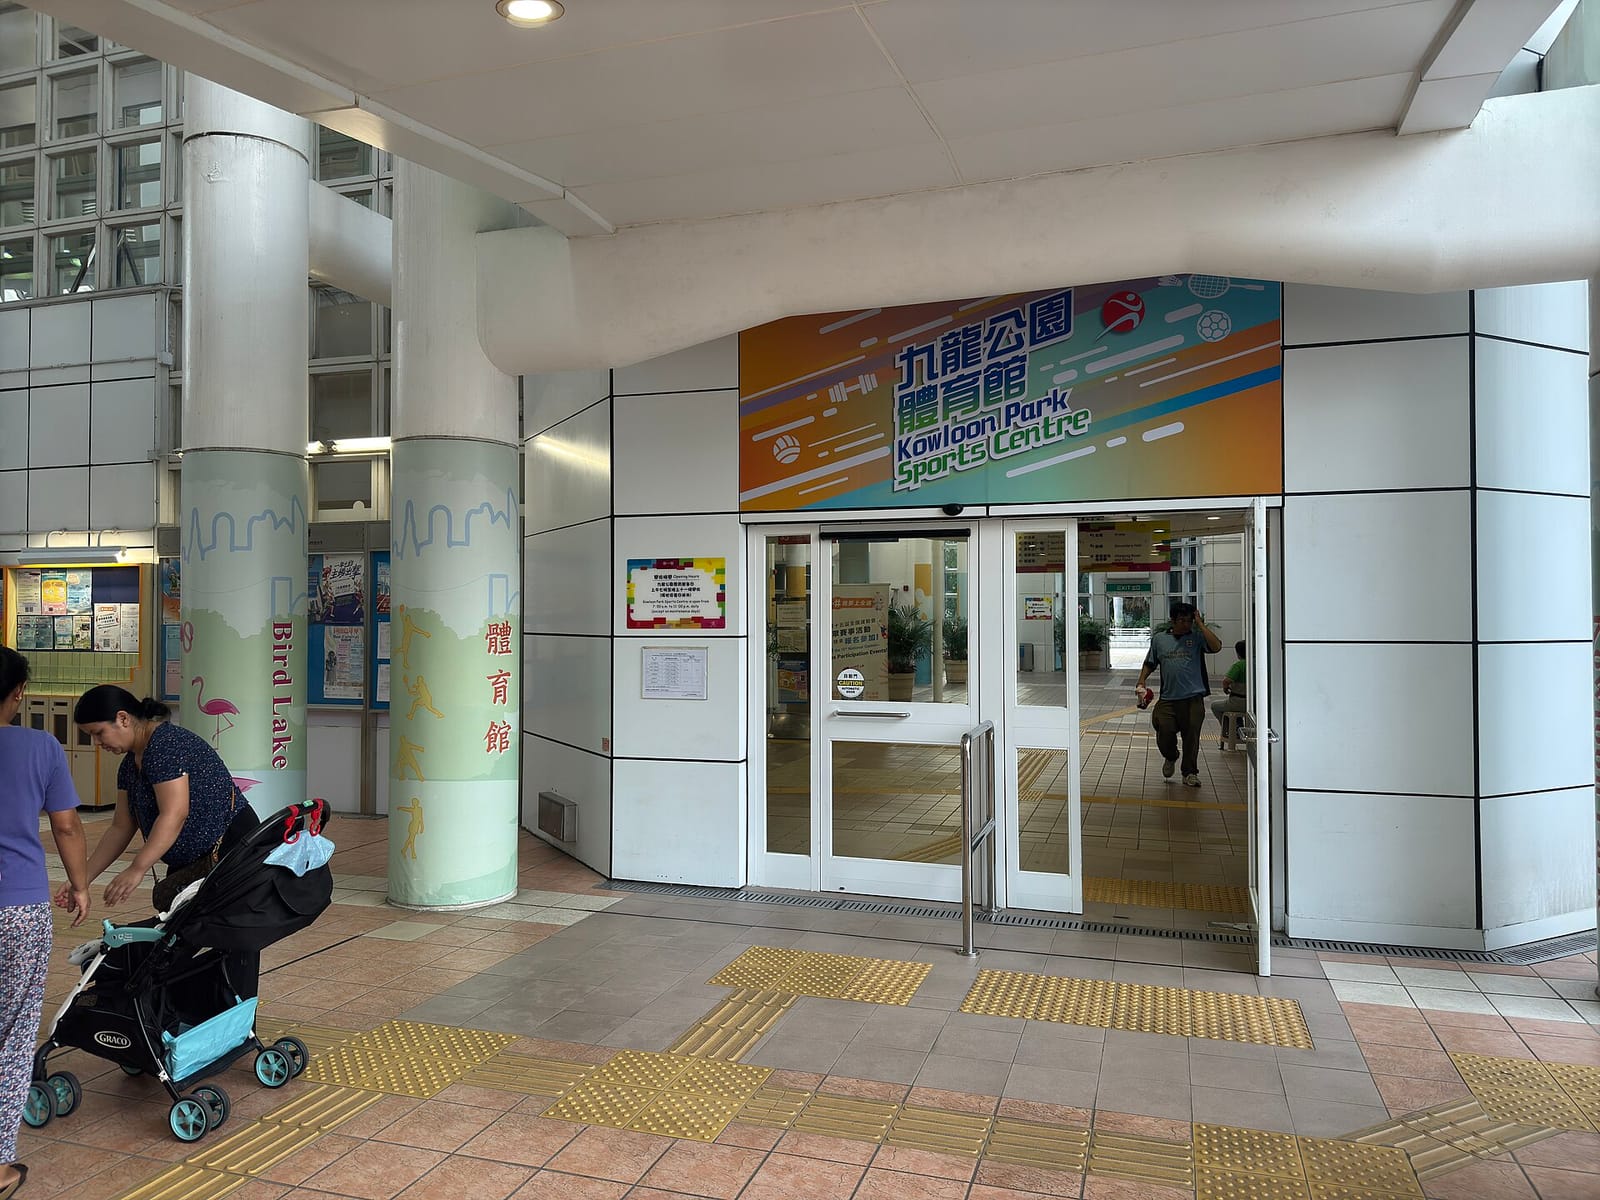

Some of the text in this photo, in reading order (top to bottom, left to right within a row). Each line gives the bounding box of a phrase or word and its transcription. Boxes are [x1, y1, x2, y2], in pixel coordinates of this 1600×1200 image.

[897, 289, 1072, 392] 九龍公園
[897, 354, 1027, 435] 體育館
[897, 388, 1068, 462] Kowloon Park
[897, 409, 1089, 485] Sports Centre
[832, 617, 876, 629] 十五屆全國運動會
[837, 650, 869, 660] Participation
[271, 620, 293, 770] Bird Lake
[483, 619, 513, 755] 體育館
[98, 1033, 128, 1046] GRACO
